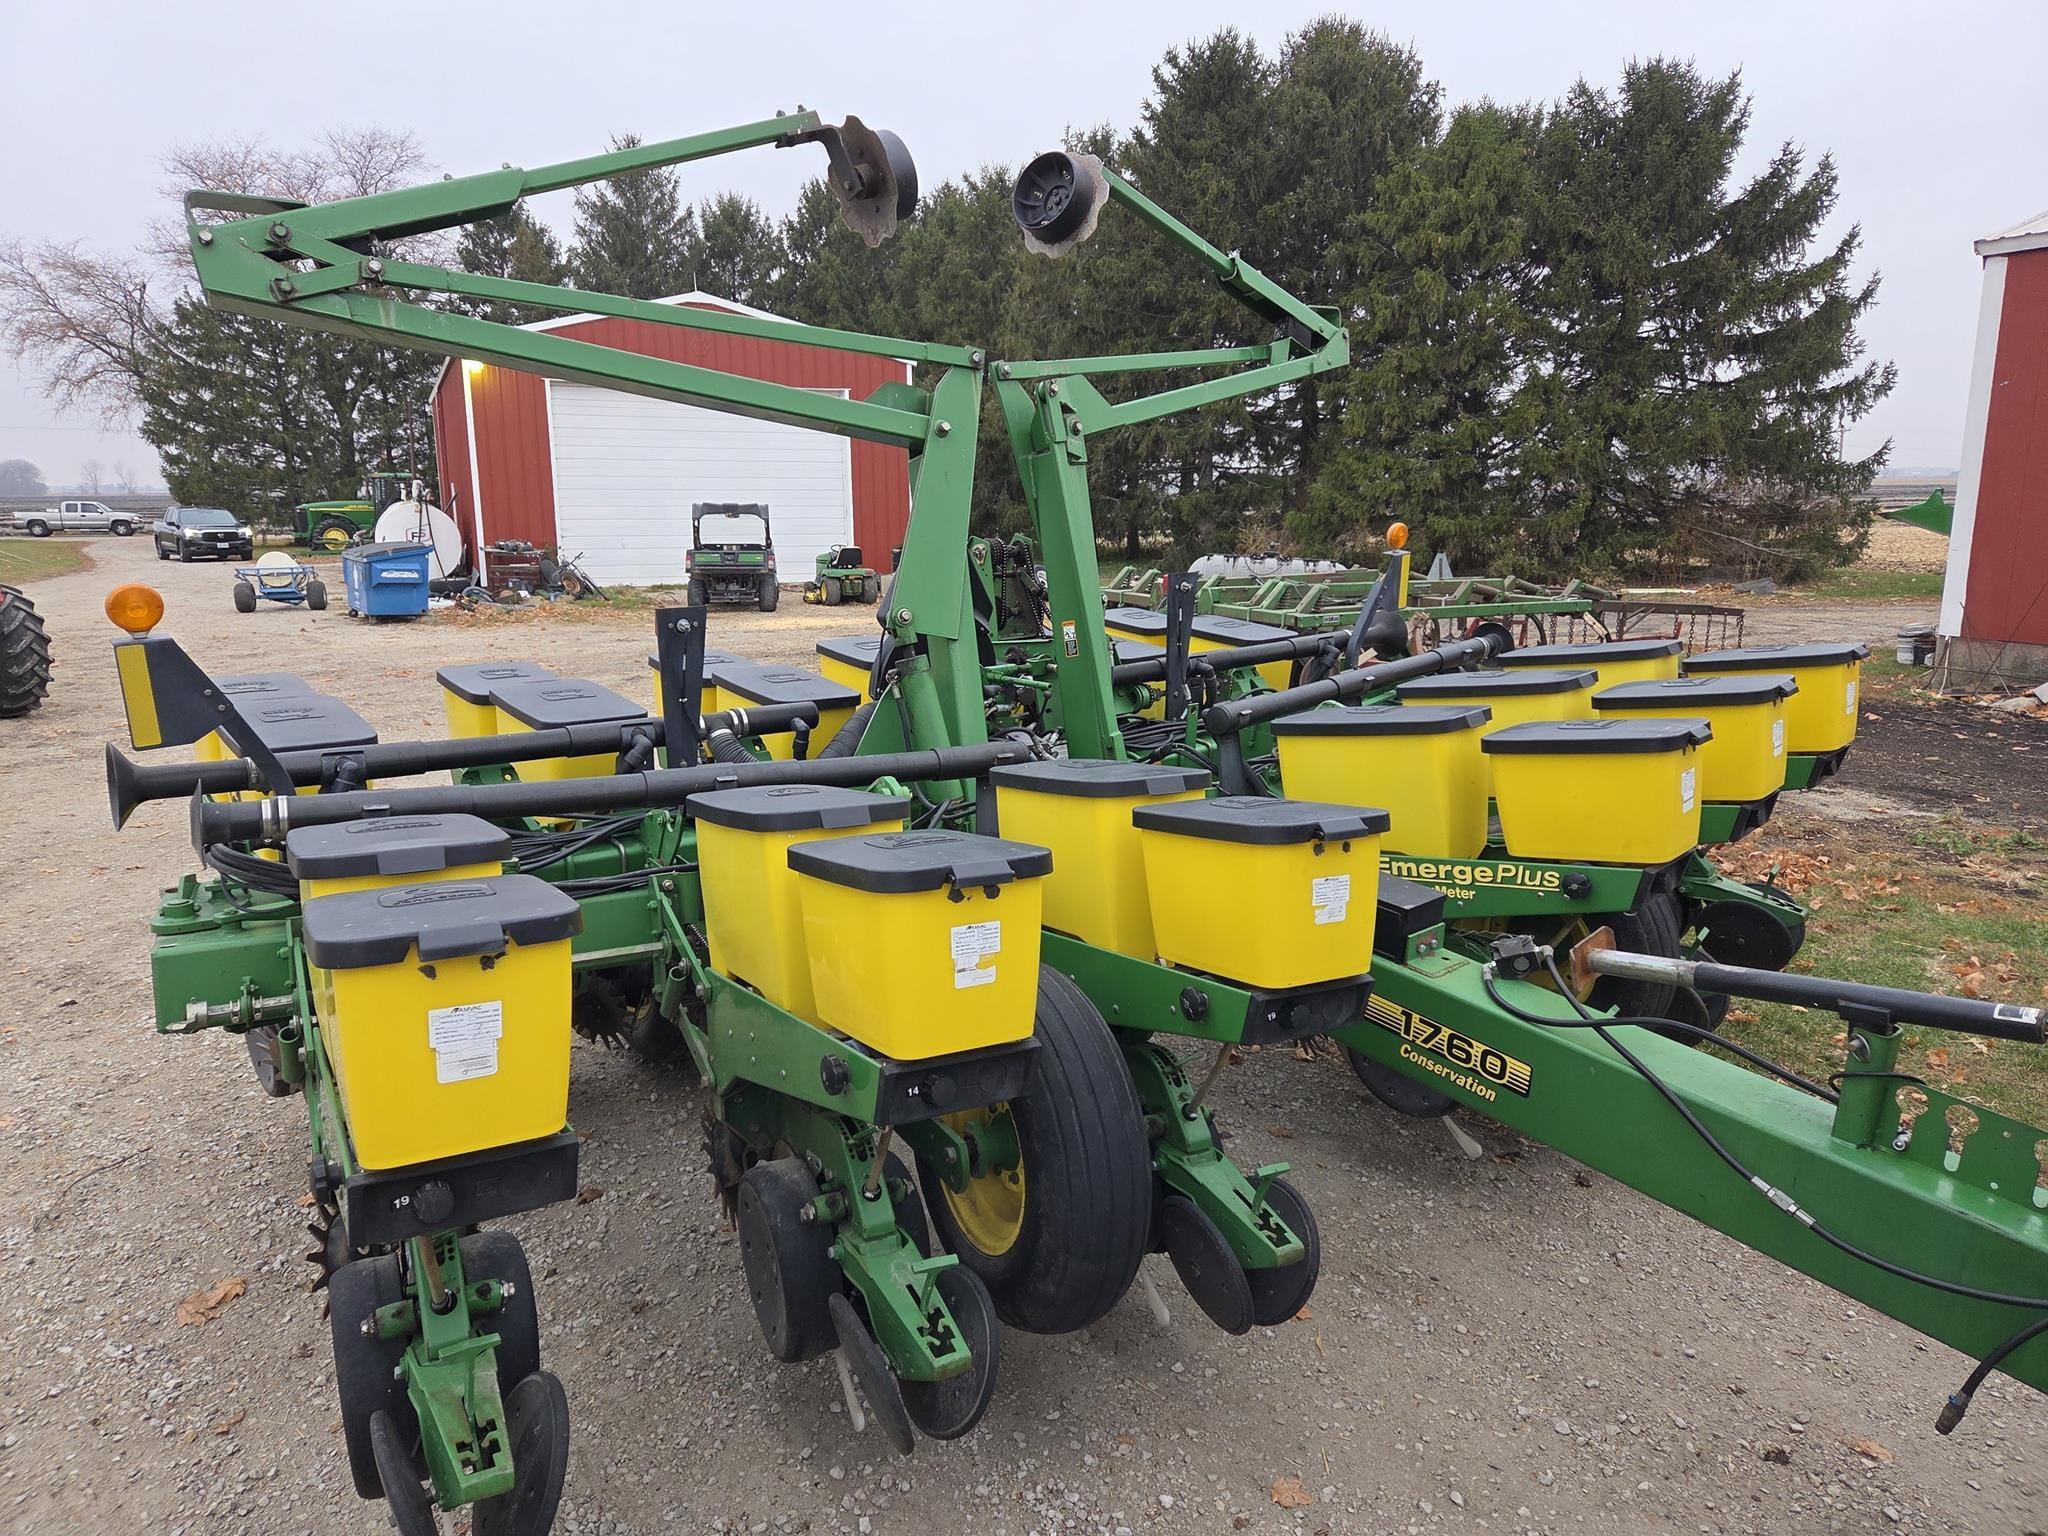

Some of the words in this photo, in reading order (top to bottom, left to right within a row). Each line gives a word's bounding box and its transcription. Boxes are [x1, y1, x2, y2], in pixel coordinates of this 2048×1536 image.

[1380, 857, 1561, 888] EmergePlus
[1267, 1011, 1276, 1021] 19
[1400, 1009, 1510, 1084] 1760
[1400, 1043, 1497, 1102] Conservation
[907, 1086, 919, 1097] 14
[393, 1195, 410, 1209] 19
